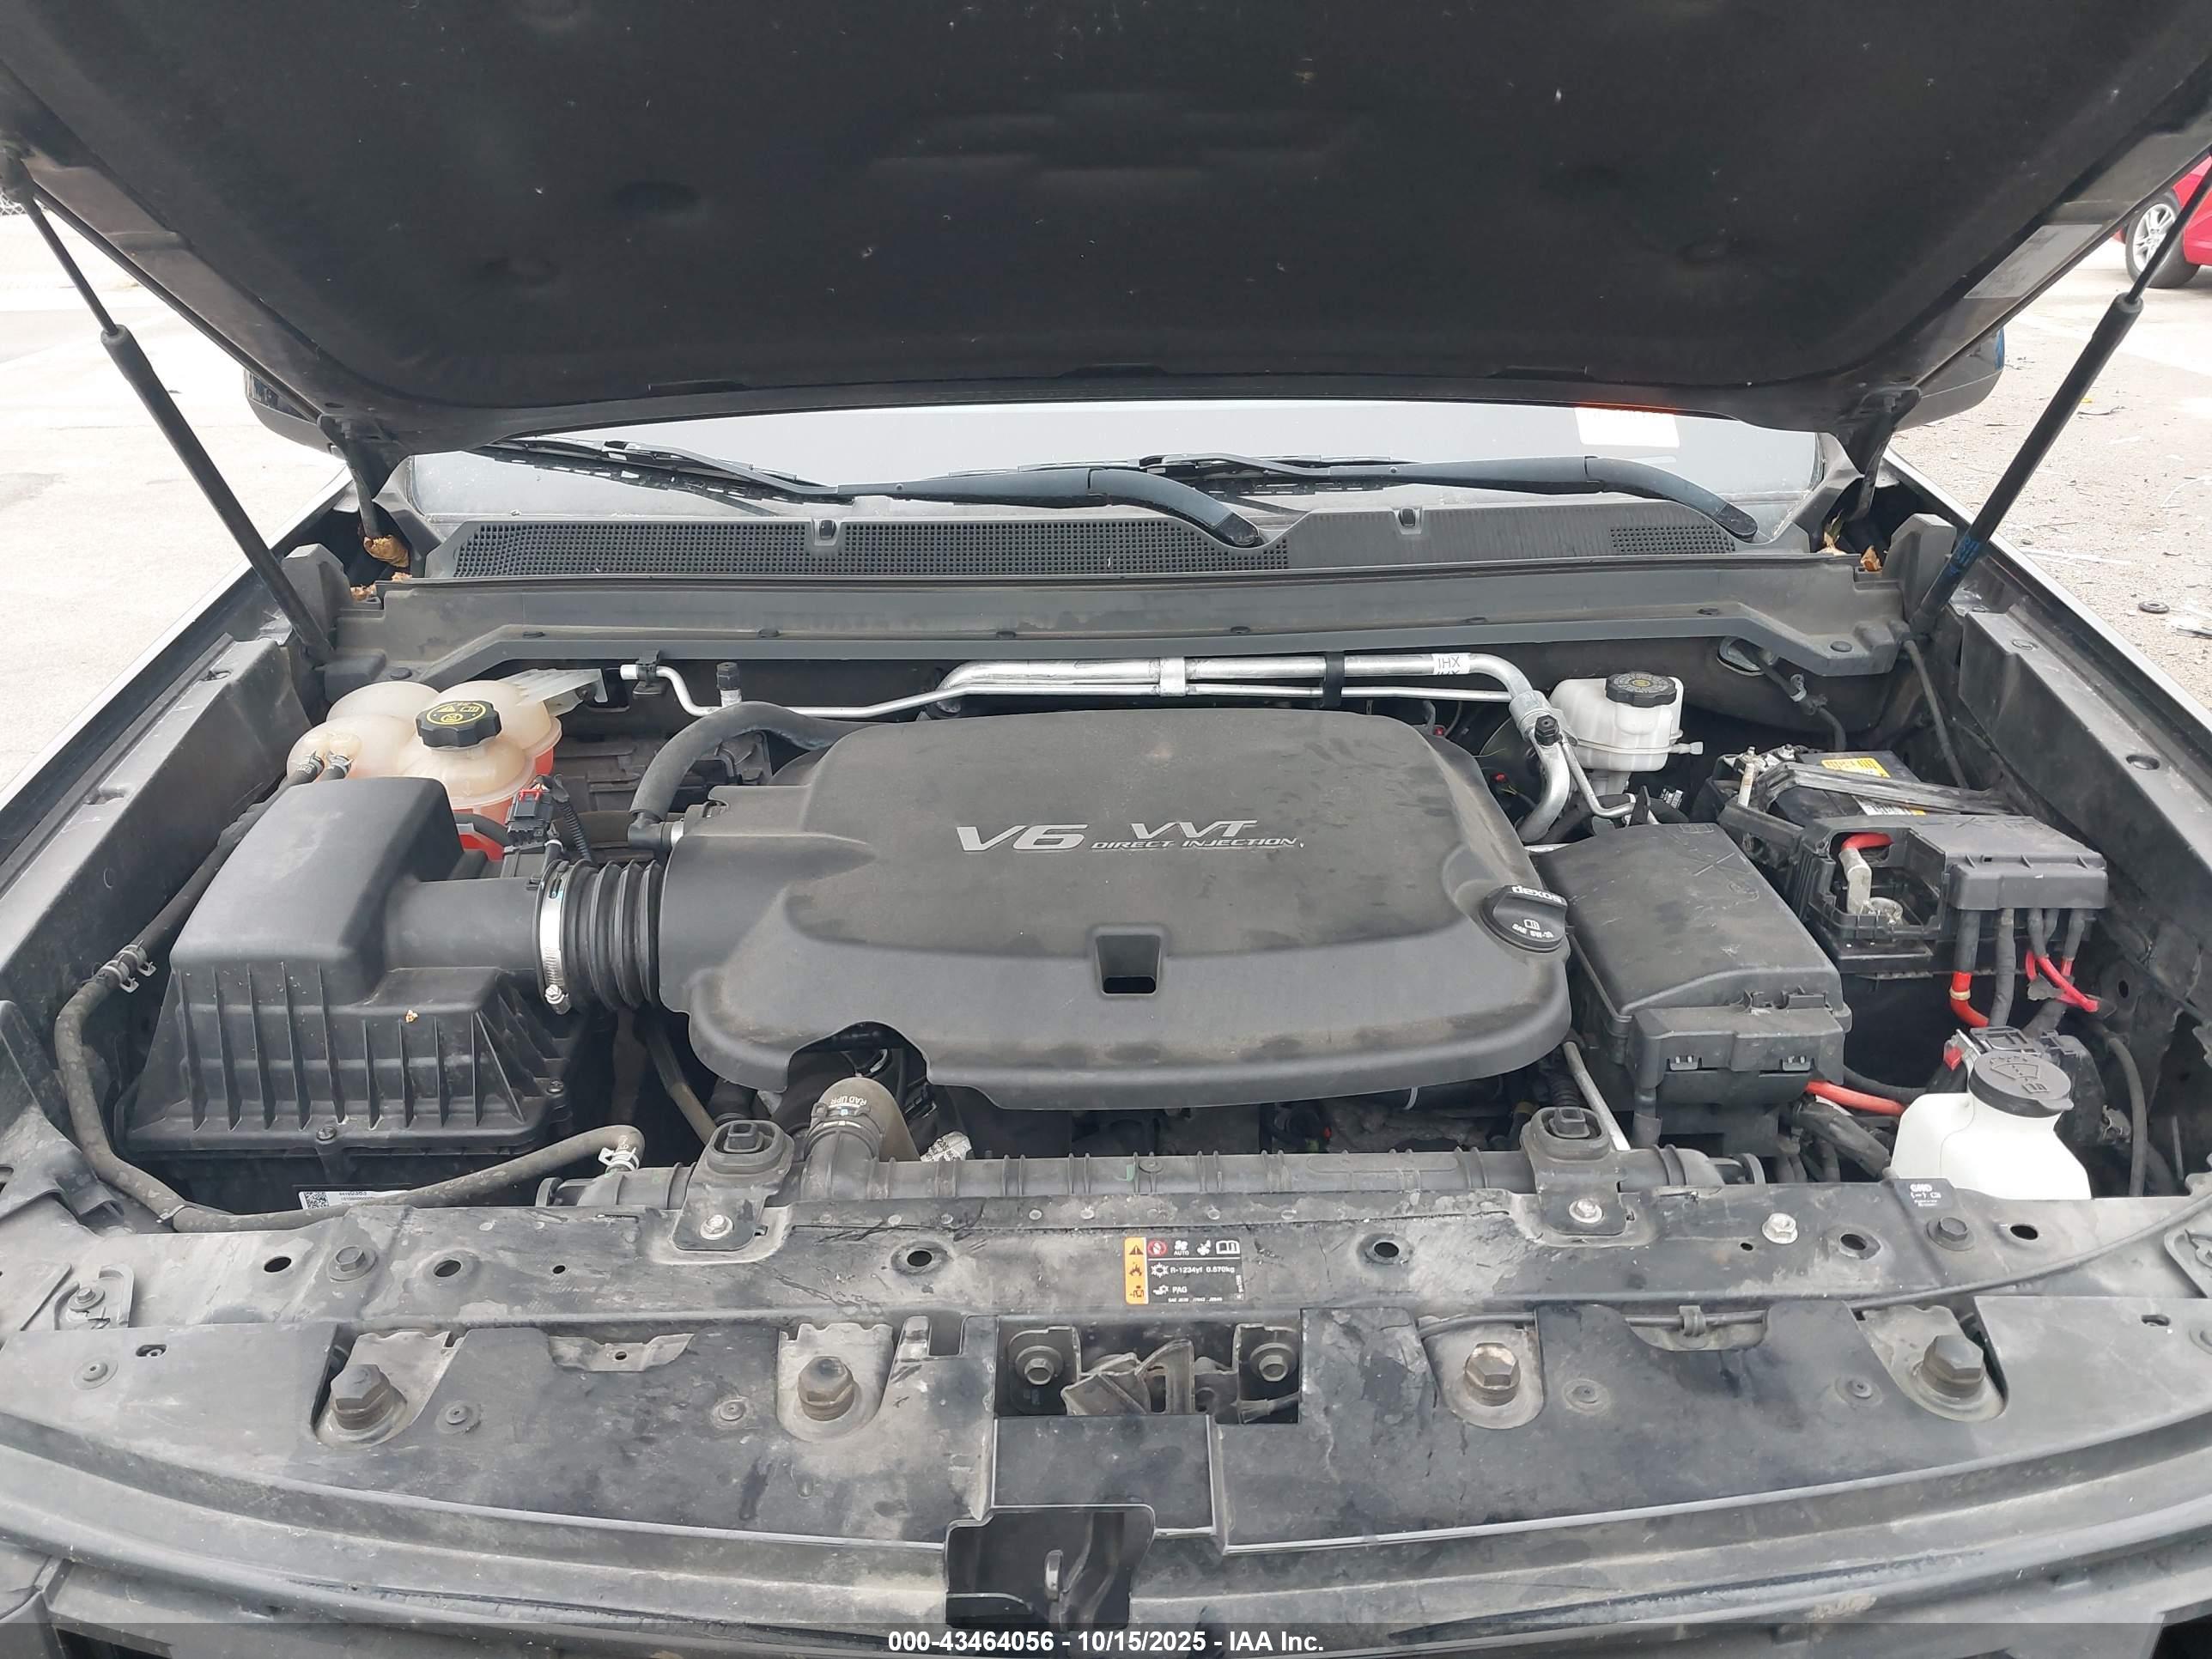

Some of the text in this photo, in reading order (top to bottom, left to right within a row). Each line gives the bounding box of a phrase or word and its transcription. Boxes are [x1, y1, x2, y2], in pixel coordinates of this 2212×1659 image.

[957, 820, 1257, 851] V6 VVT
[1091, 837, 1297, 850] DIRECT INJECTION
[1511, 885, 1562, 903] dexos
[830, 1096, 866, 1106] RAD UPR
